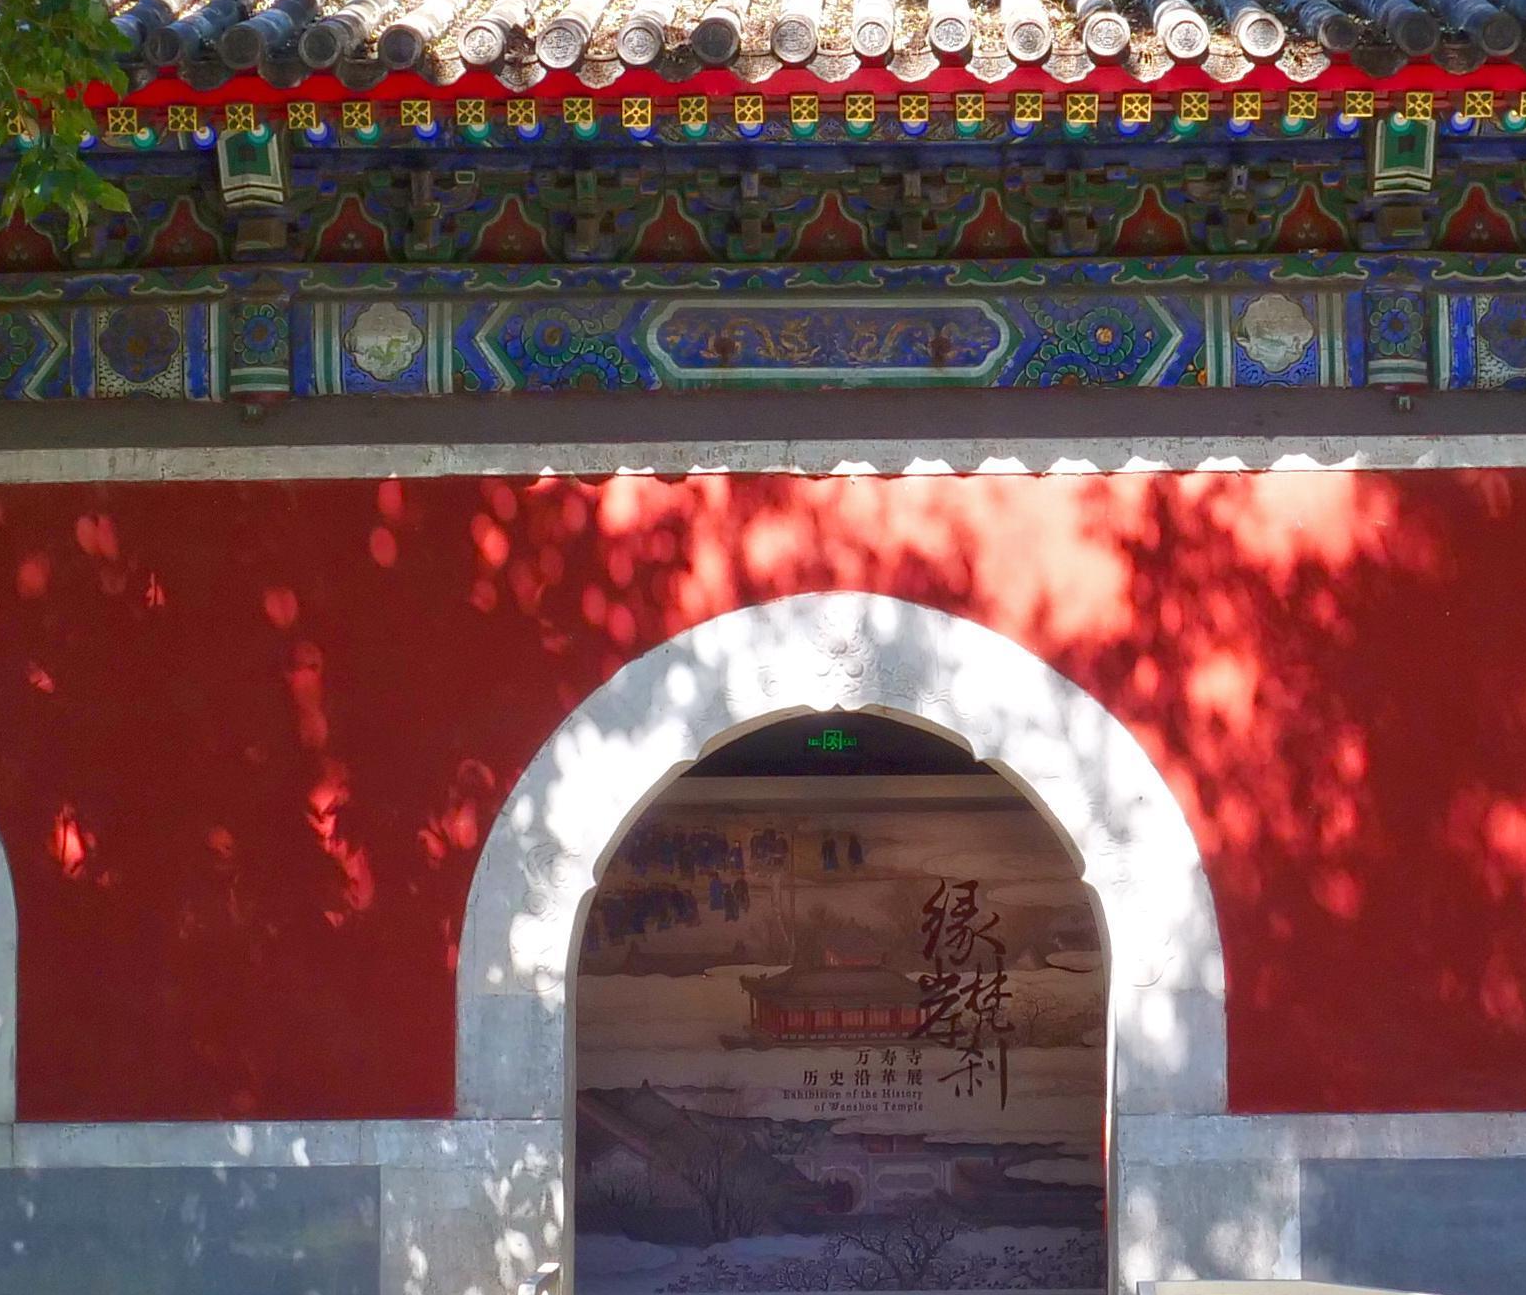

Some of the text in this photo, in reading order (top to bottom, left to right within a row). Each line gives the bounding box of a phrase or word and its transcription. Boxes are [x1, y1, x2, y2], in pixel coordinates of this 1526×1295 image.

[855, 1048, 923, 1066] 万寿寺
[803, 1069, 923, 1087] 历史沿革展
[783, 1089, 923, 1101] Exhibition of the History
[814, 1102, 924, 1113] of Wanshou Temple
